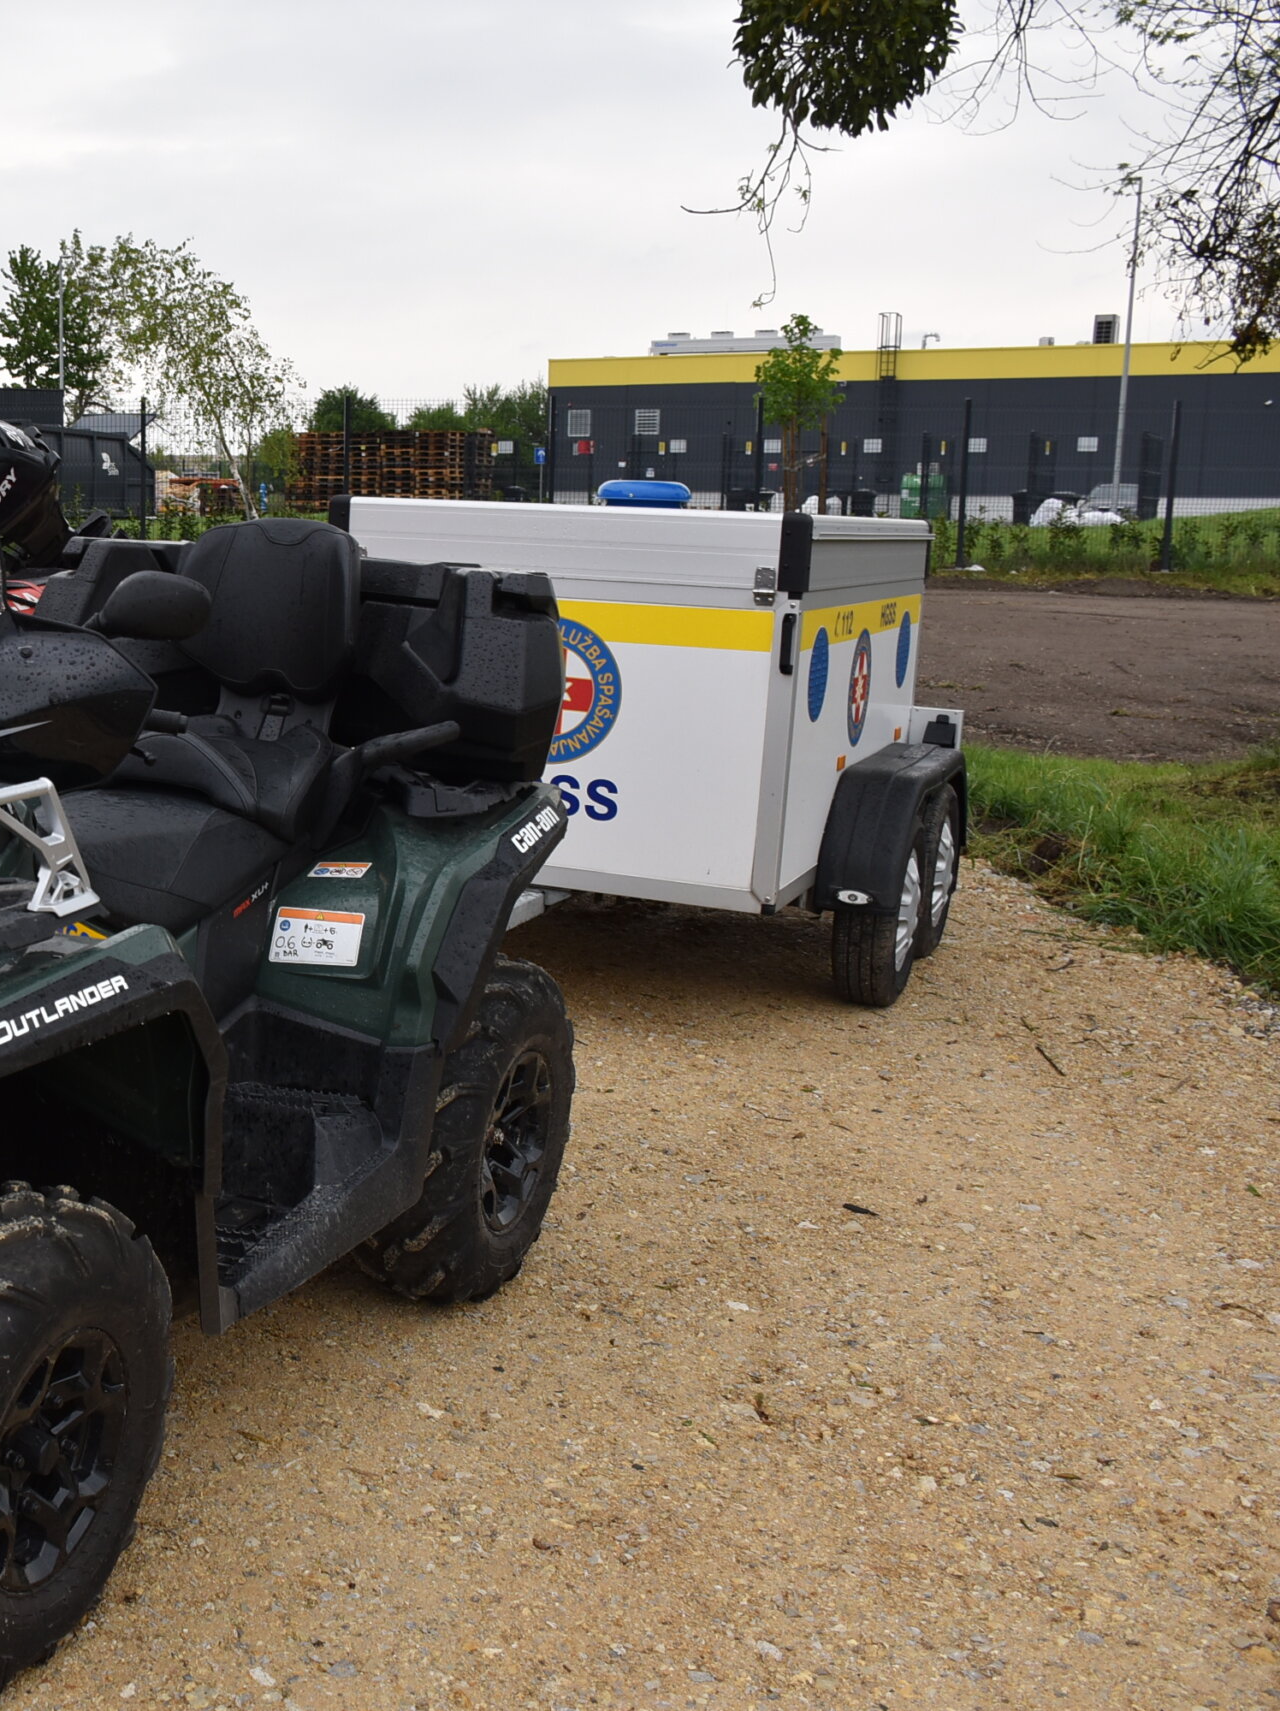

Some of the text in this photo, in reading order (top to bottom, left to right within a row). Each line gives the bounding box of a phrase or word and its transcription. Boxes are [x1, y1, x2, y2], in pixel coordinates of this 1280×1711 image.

[880, 601, 897, 628] HGSS
[550, 624, 615, 757] LUŽBA SPAŠAVANJA
[510, 805, 561, 854] can-am
[283, 950, 299, 958] BAR
